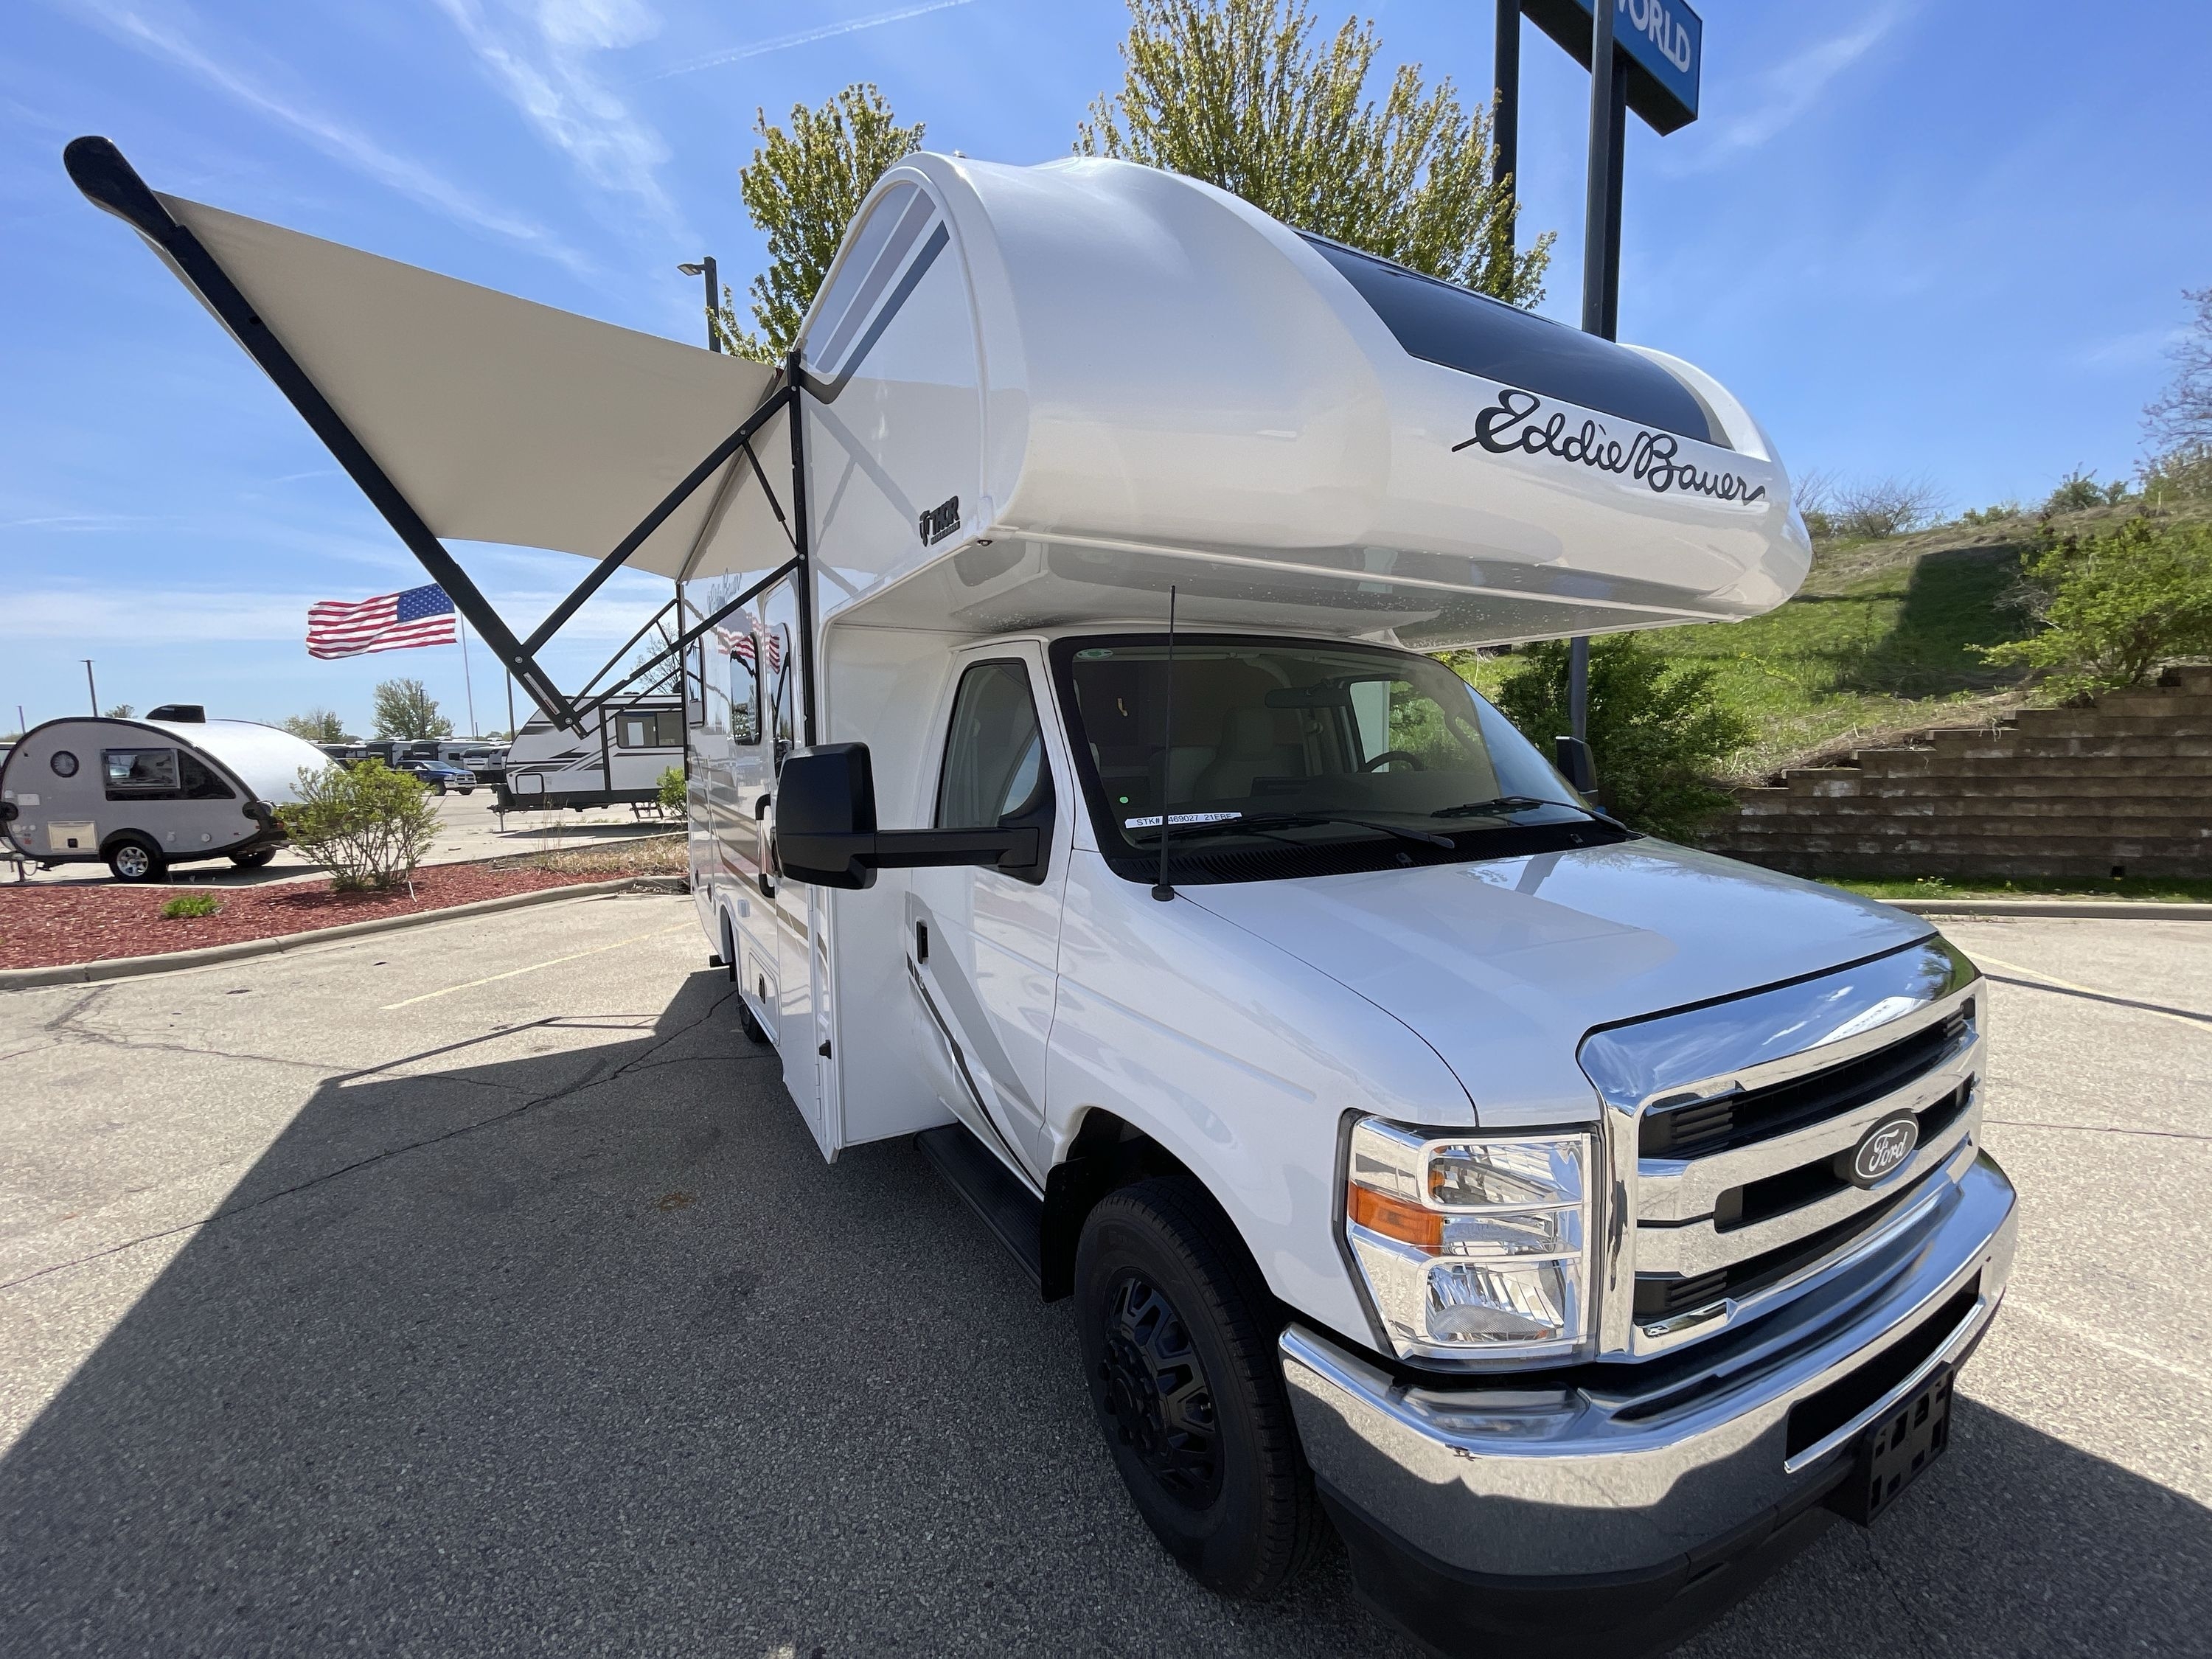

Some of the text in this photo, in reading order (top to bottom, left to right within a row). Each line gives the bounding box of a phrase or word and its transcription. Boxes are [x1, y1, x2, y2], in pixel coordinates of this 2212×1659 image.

[1618, 0, 1691, 73] ORLD
[1136, 817, 1161, 827] STK#
[1168, 815, 1199, 824] 469027
[1868, 1128, 1908, 1172] Ford
